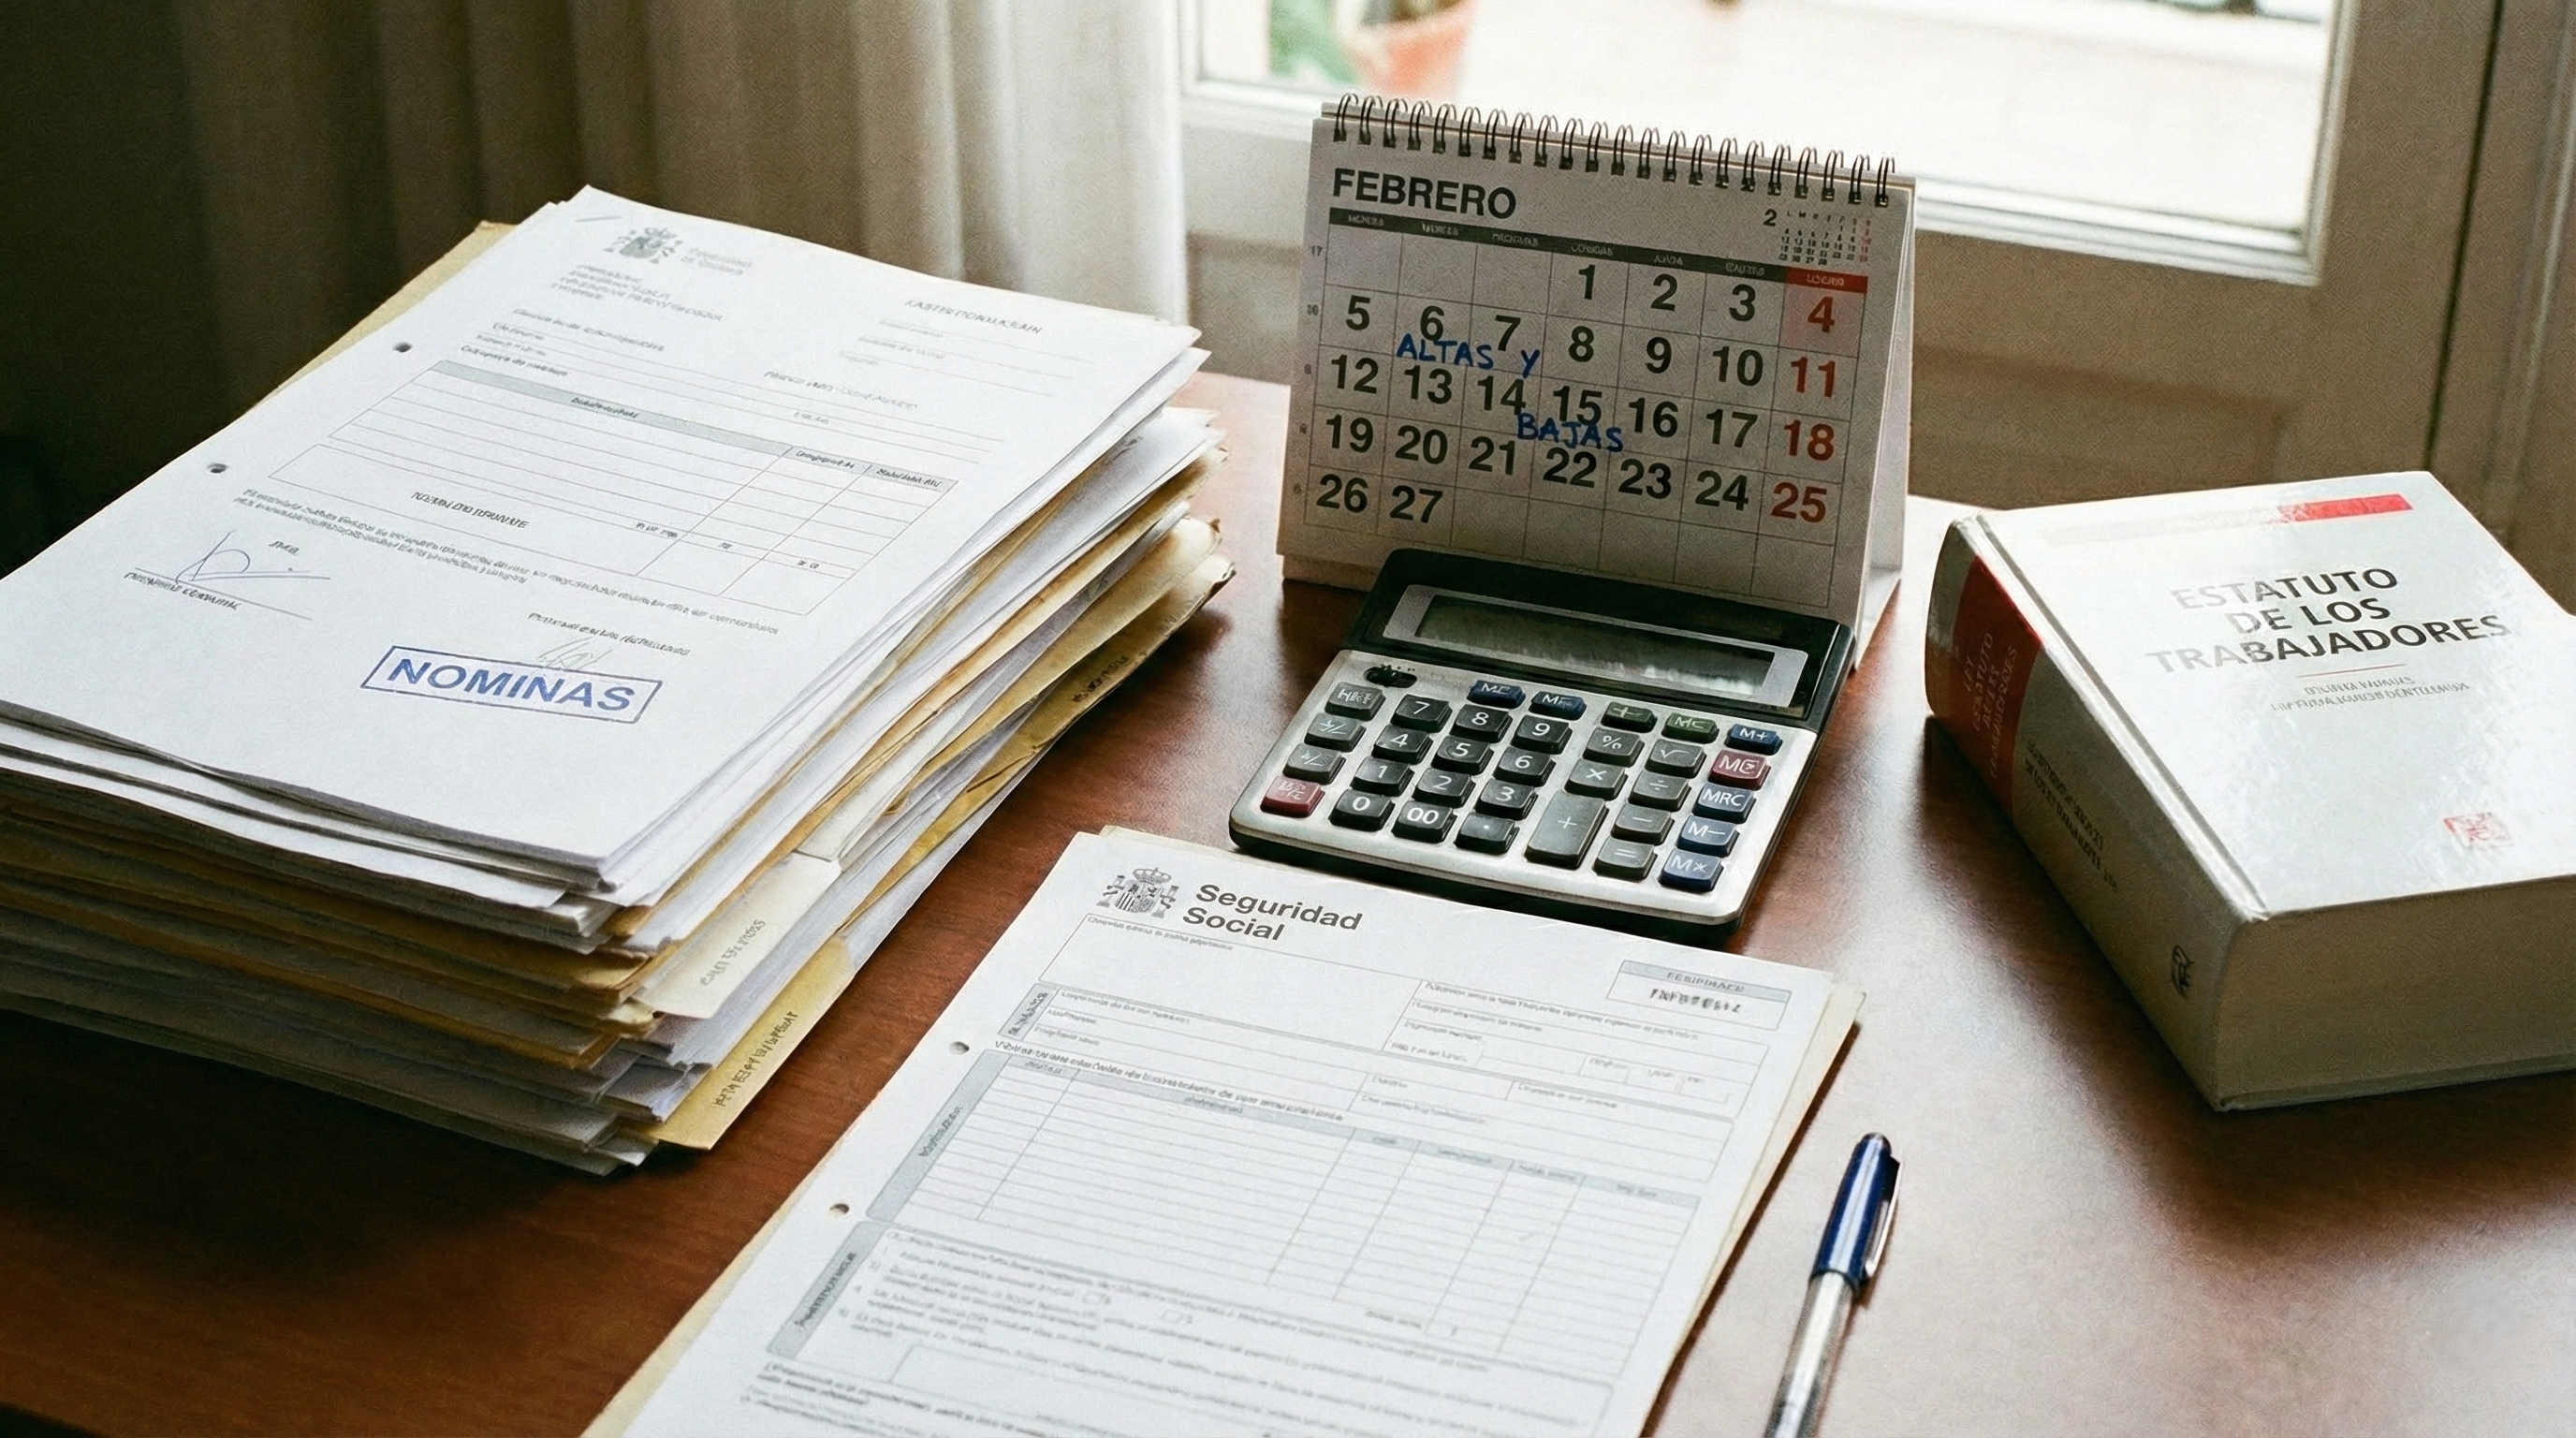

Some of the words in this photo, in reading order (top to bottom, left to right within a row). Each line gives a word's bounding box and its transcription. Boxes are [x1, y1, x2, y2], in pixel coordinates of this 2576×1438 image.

[1333, 168, 1516, 220] FEBRERO
[1763, 209, 1778, 227] 2
[1578, 264, 1596, 301] 1
[1650, 273, 1678, 312] 2
[1728, 284, 1757, 321] 3
[1808, 296, 1836, 333] 4
[1345, 295, 1371, 330] 5
[1419, 305, 1445, 342] 6
[1494, 315, 1522, 352] 7
[1568, 325, 1595, 362] 8
[1646, 337, 1672, 374] 9
[1712, 345, 1764, 387] 10
[1791, 356, 1837, 398] 11
[1396, 333, 1494, 371] ALTAS
[1330, 354, 1379, 394] 12
[1404, 364, 1453, 404] 13
[1477, 374, 1527, 416] 14
[1553, 385, 1603, 426] 15
[1629, 397, 1679, 438] 16
[1705, 408, 1758, 448] 17
[1783, 419, 1835, 461] 18
[1516, 412, 1624, 453] BAJAS
[1325, 414, 1373, 453] 19
[1394, 424, 1448, 465] 20
[1468, 435, 1516, 477] 21
[1543, 447, 1598, 489] 22
[1617, 459, 1672, 500] 23
[1694, 470, 1749, 511] 24
[1770, 482, 1827, 523] 25
[1316, 474, 1368, 514] 26
[1389, 485, 1444, 524] 27
[2170, 567, 2398, 610] ESTATUTO
[2224, 608, 2293, 635] DE
[2299, 597, 2391, 626] LOS
[2145, 614, 2512, 673] TRABAJADORES
[387, 658, 637, 712] NOMINAS
[1413, 701, 1430, 714] 7
[1471, 712, 1489, 726] 8
[1390, 733, 1409, 747] 4
[1531, 723, 1550, 736] 9
[1452, 742, 1471, 757] 5
[1515, 755, 1533, 769] 6
[1378, 765, 1388, 779] 1
[1432, 775, 1452, 790] 2
[1352, 797, 1370, 811] 0
[1495, 786, 1515, 801] 3
[1702, 788, 1746, 807] MRC
[1407, 807, 1439, 823] 00
[1182, 906, 1285, 941] Social
[1195, 884, 1364, 931] Seguridad
